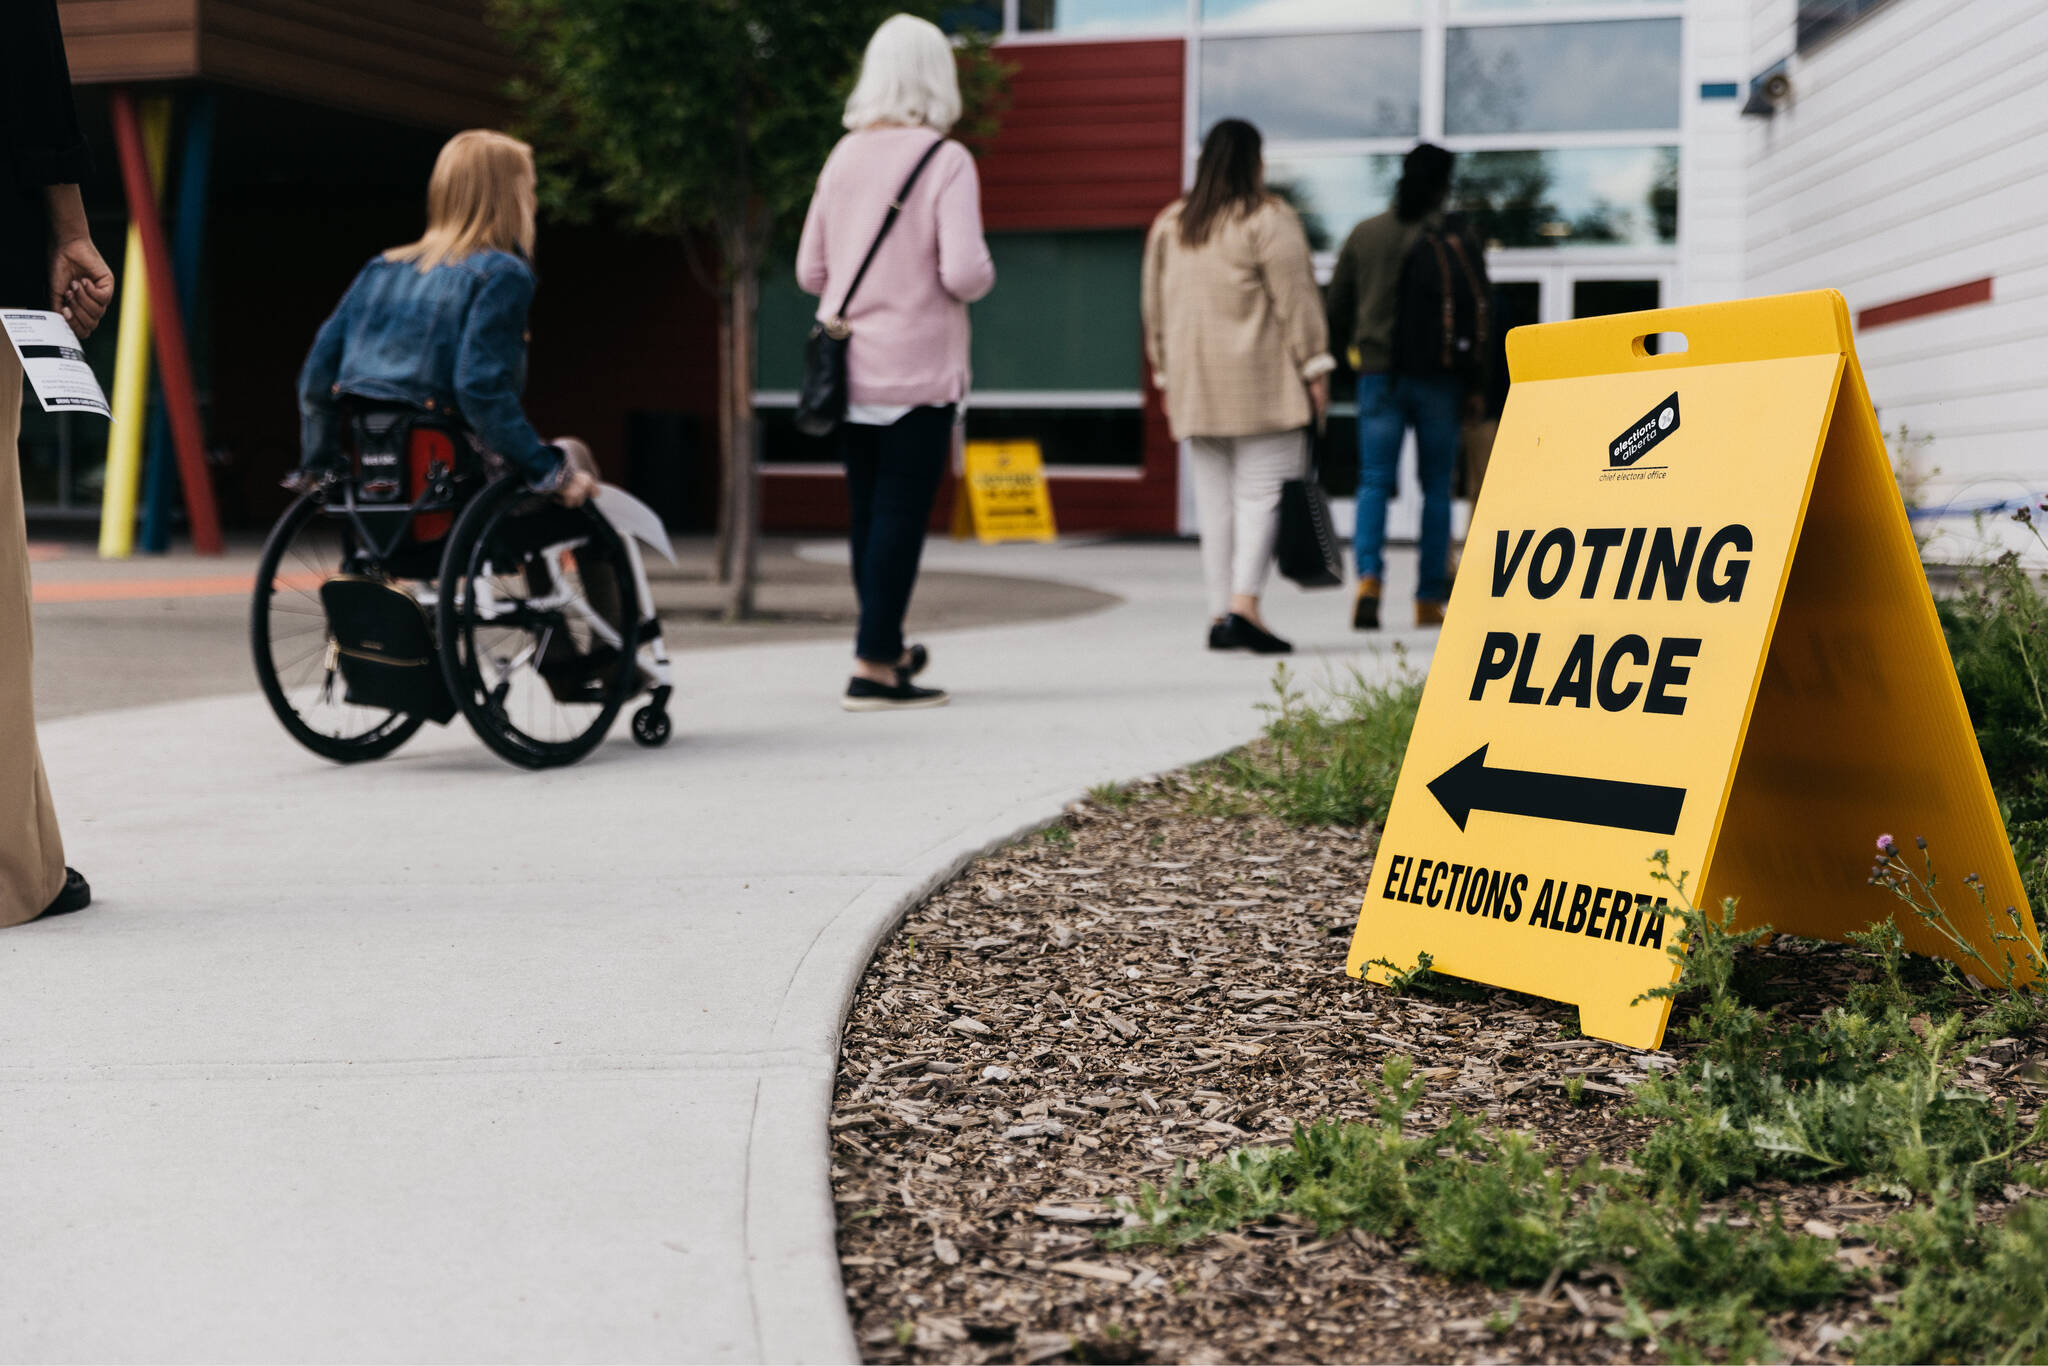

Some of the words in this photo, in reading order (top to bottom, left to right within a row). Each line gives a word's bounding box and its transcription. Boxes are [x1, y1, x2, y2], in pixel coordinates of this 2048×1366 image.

[1613, 418, 1657, 456] elections
[1622, 429, 1657, 460] alberta
[1599, 471, 1616, 482] chief
[1616, 470, 1646, 481] electoral
[1647, 470, 1667, 480] office
[1491, 524, 1753, 603] VOTING
[1469, 631, 1703, 716] PLACE
[1382, 854, 1528, 922] ELECTIONS
[1528, 879, 1668, 950] ALBERTA
